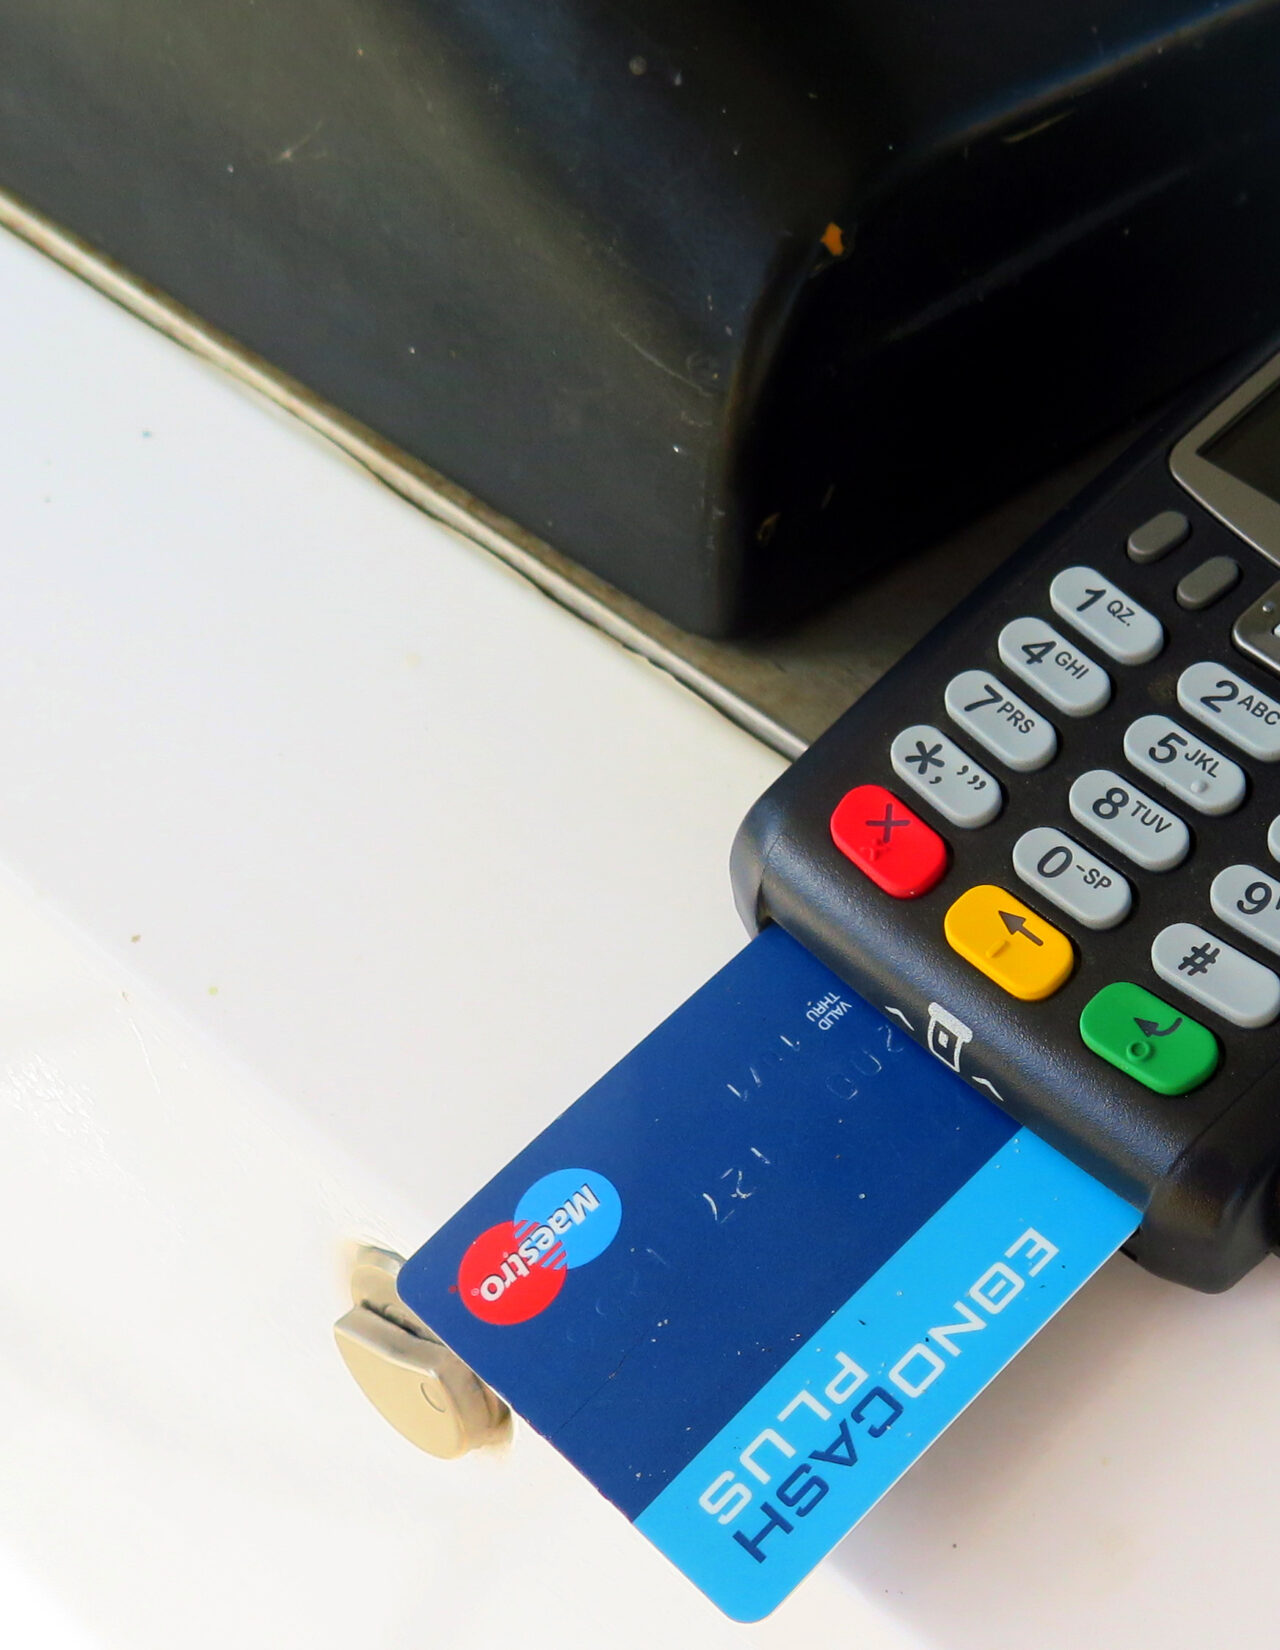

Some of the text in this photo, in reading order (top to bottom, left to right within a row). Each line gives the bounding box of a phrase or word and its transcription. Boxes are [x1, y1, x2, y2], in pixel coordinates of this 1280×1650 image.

[1076, 588, 1106, 612] 1
[1021, 640, 1090, 680] 4 GHI
[964, 684, 1035, 734] 7 PRS
[1200, 680, 1239, 714] 2
[1148, 732, 1219, 778] 5 JKL
[1091, 787, 1173, 834] 8 TUV
[1037, 846, 1073, 878] 0
[1236, 881, 1273, 915] 9
[1177, 942, 1221, 976] #
[806, 992, 841, 1022] THRU
[818, 1000, 852, 1031] VALID
[480, 1183, 601, 1302] Maestro
[700, 1351, 869, 1525] PLUS
